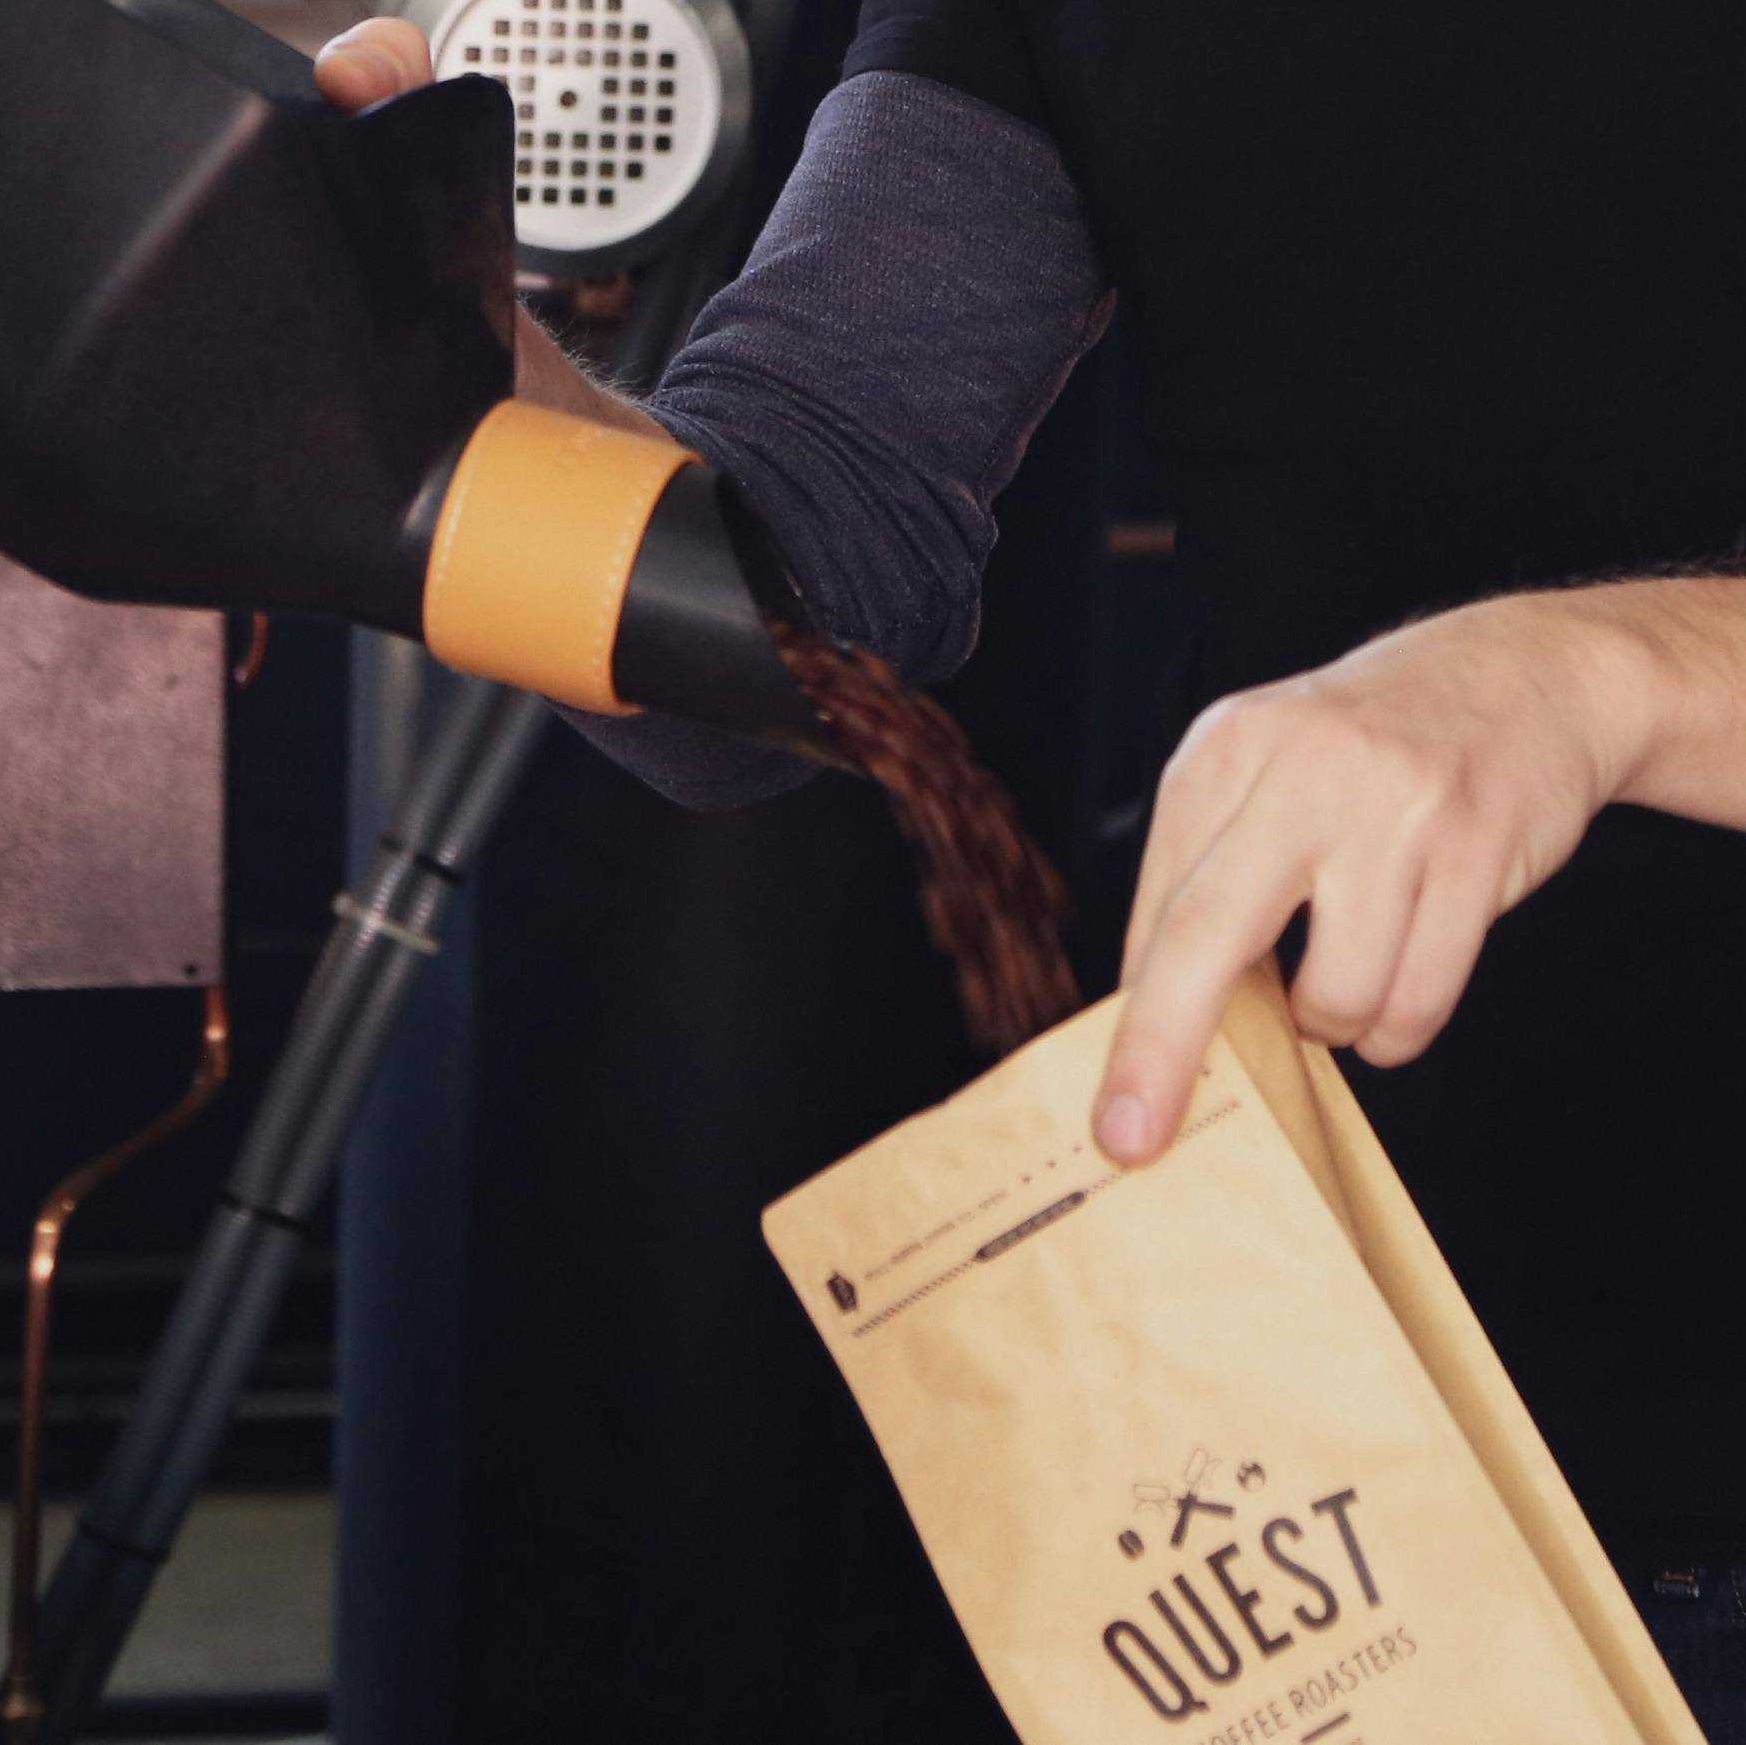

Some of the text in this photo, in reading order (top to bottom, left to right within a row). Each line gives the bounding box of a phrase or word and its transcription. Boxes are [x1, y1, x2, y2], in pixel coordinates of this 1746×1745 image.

[1102, 1486, 1383, 1725] QUEST
[1197, 1625, 1419, 1745] OFFEE ROASTERS
